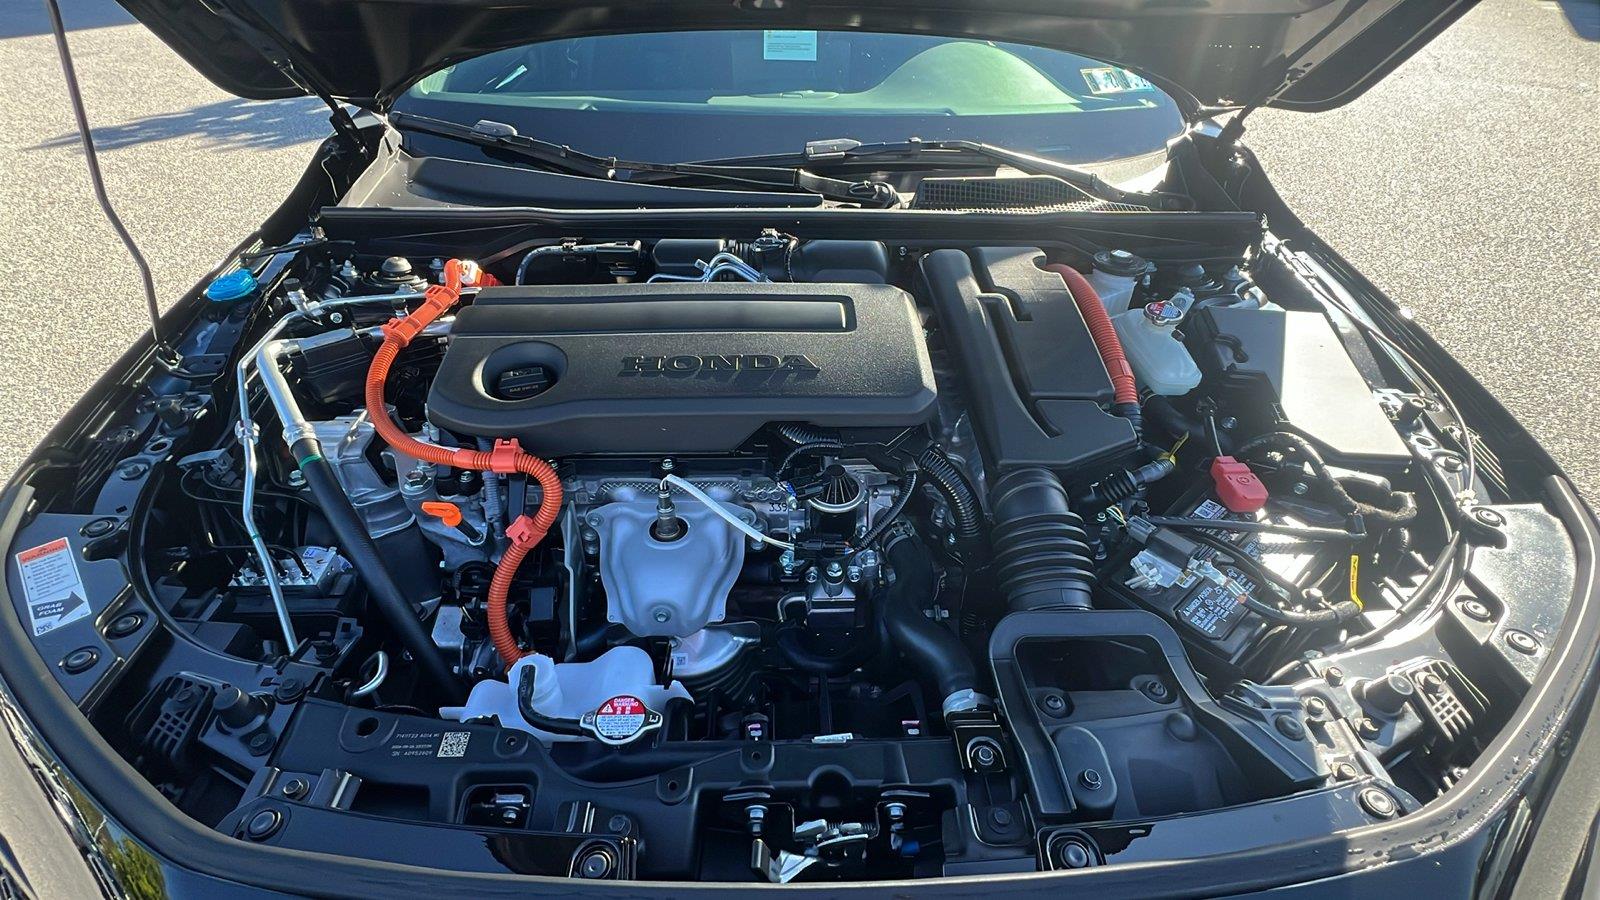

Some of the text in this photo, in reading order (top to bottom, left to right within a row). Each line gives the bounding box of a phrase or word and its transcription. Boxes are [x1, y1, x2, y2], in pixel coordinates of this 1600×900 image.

[621, 354, 821, 374] HONDA
[37, 602, 62, 612] GRAB
[38, 607, 65, 616] FOAM
